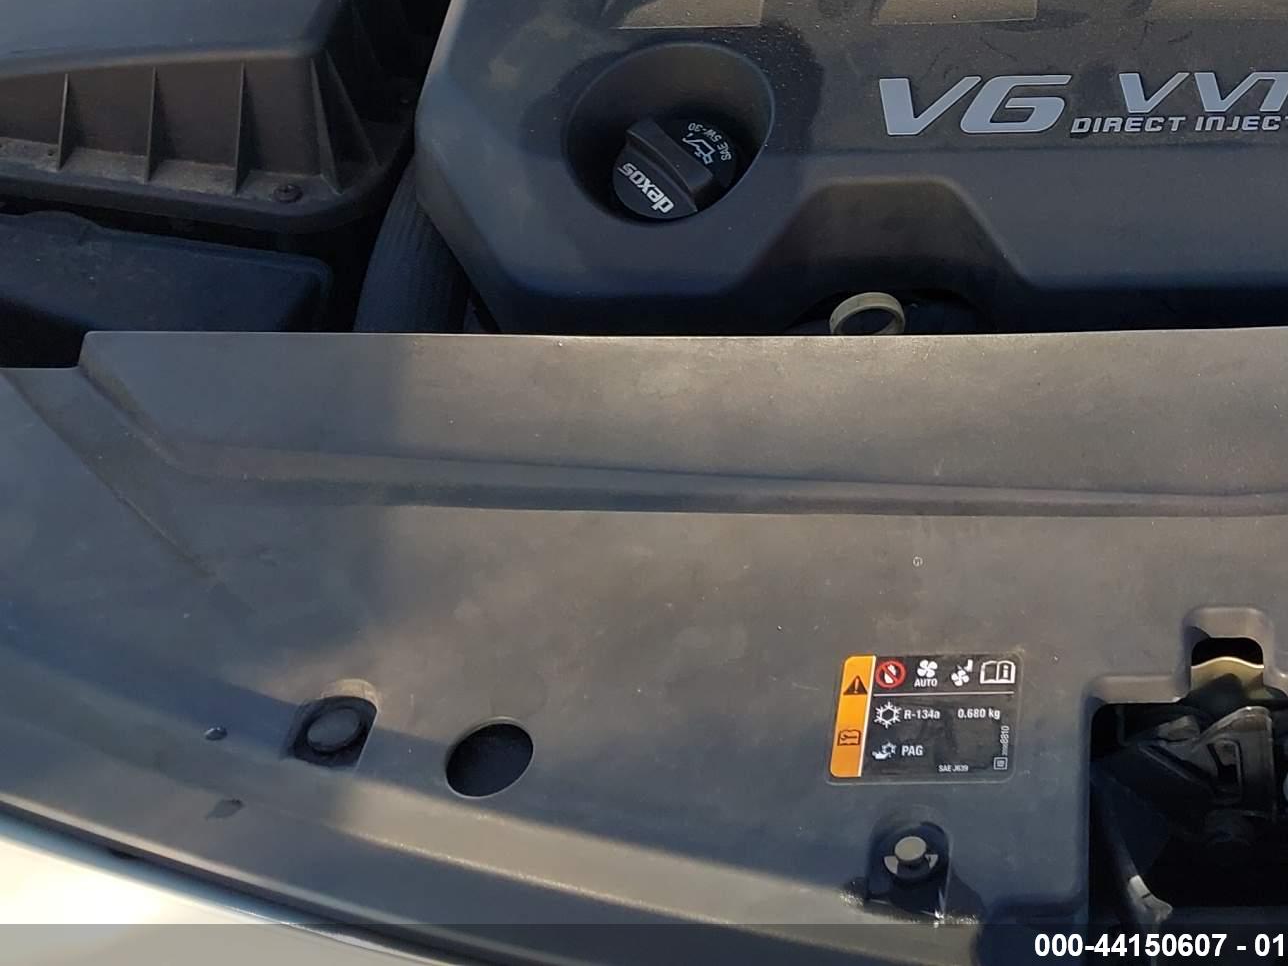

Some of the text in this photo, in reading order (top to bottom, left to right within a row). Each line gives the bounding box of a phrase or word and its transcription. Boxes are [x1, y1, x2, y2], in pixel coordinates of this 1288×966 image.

[877, 73, 1073, 137] V6
[1070, 116, 1187, 134] DIRECT
[688, 122, 732, 161] SAE 5W-30
[616, 162, 675, 214] dexos
[913, 678, 938, 688] AUTO
[903, 708, 1001, 721] R-134a 0.680 kg
[901, 745, 924, 756] PAG
